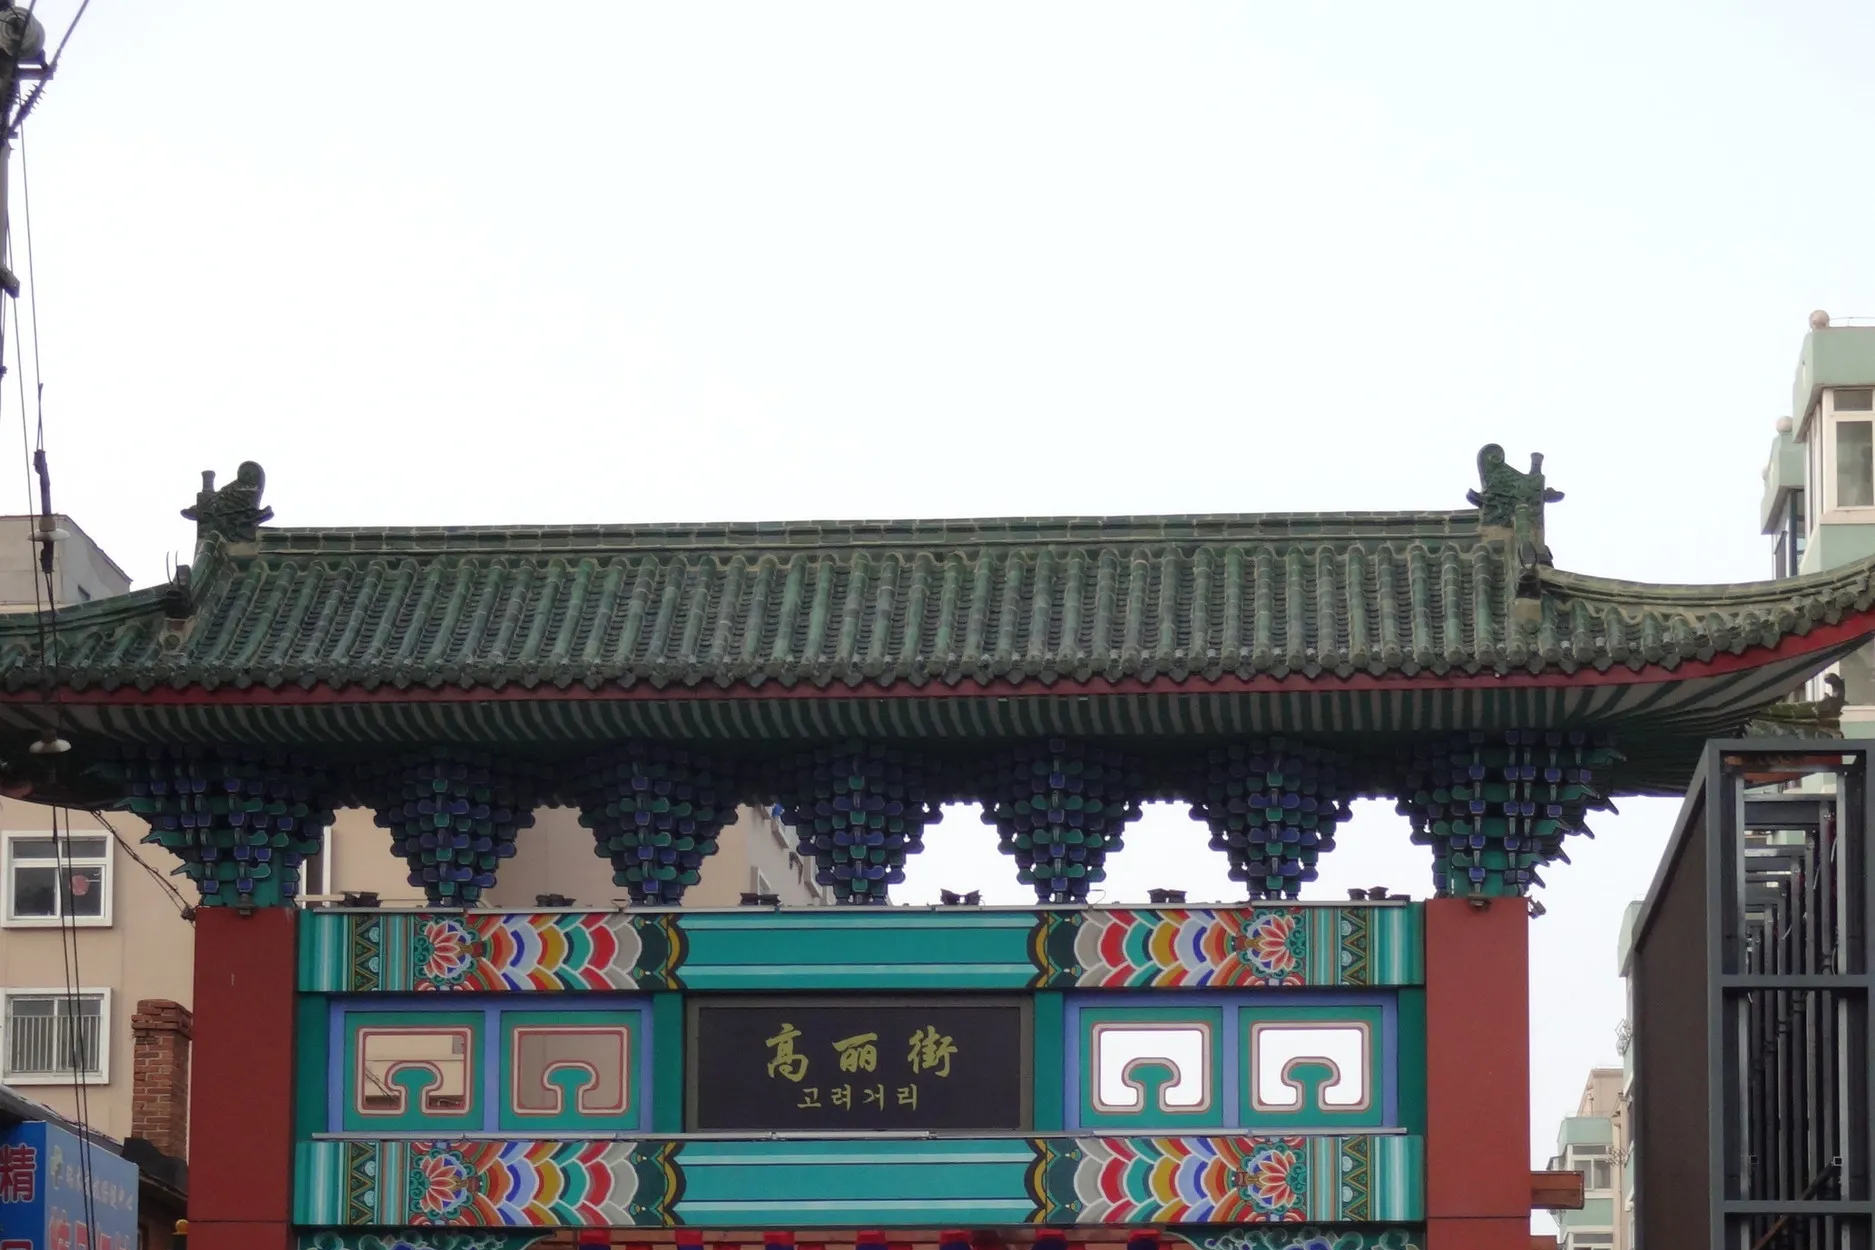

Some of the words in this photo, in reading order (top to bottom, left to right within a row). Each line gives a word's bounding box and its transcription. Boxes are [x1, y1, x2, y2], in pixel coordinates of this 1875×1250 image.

[765, 1023, 958, 1082] 高丽街
[797, 1084, 918, 1112] 고려거리
